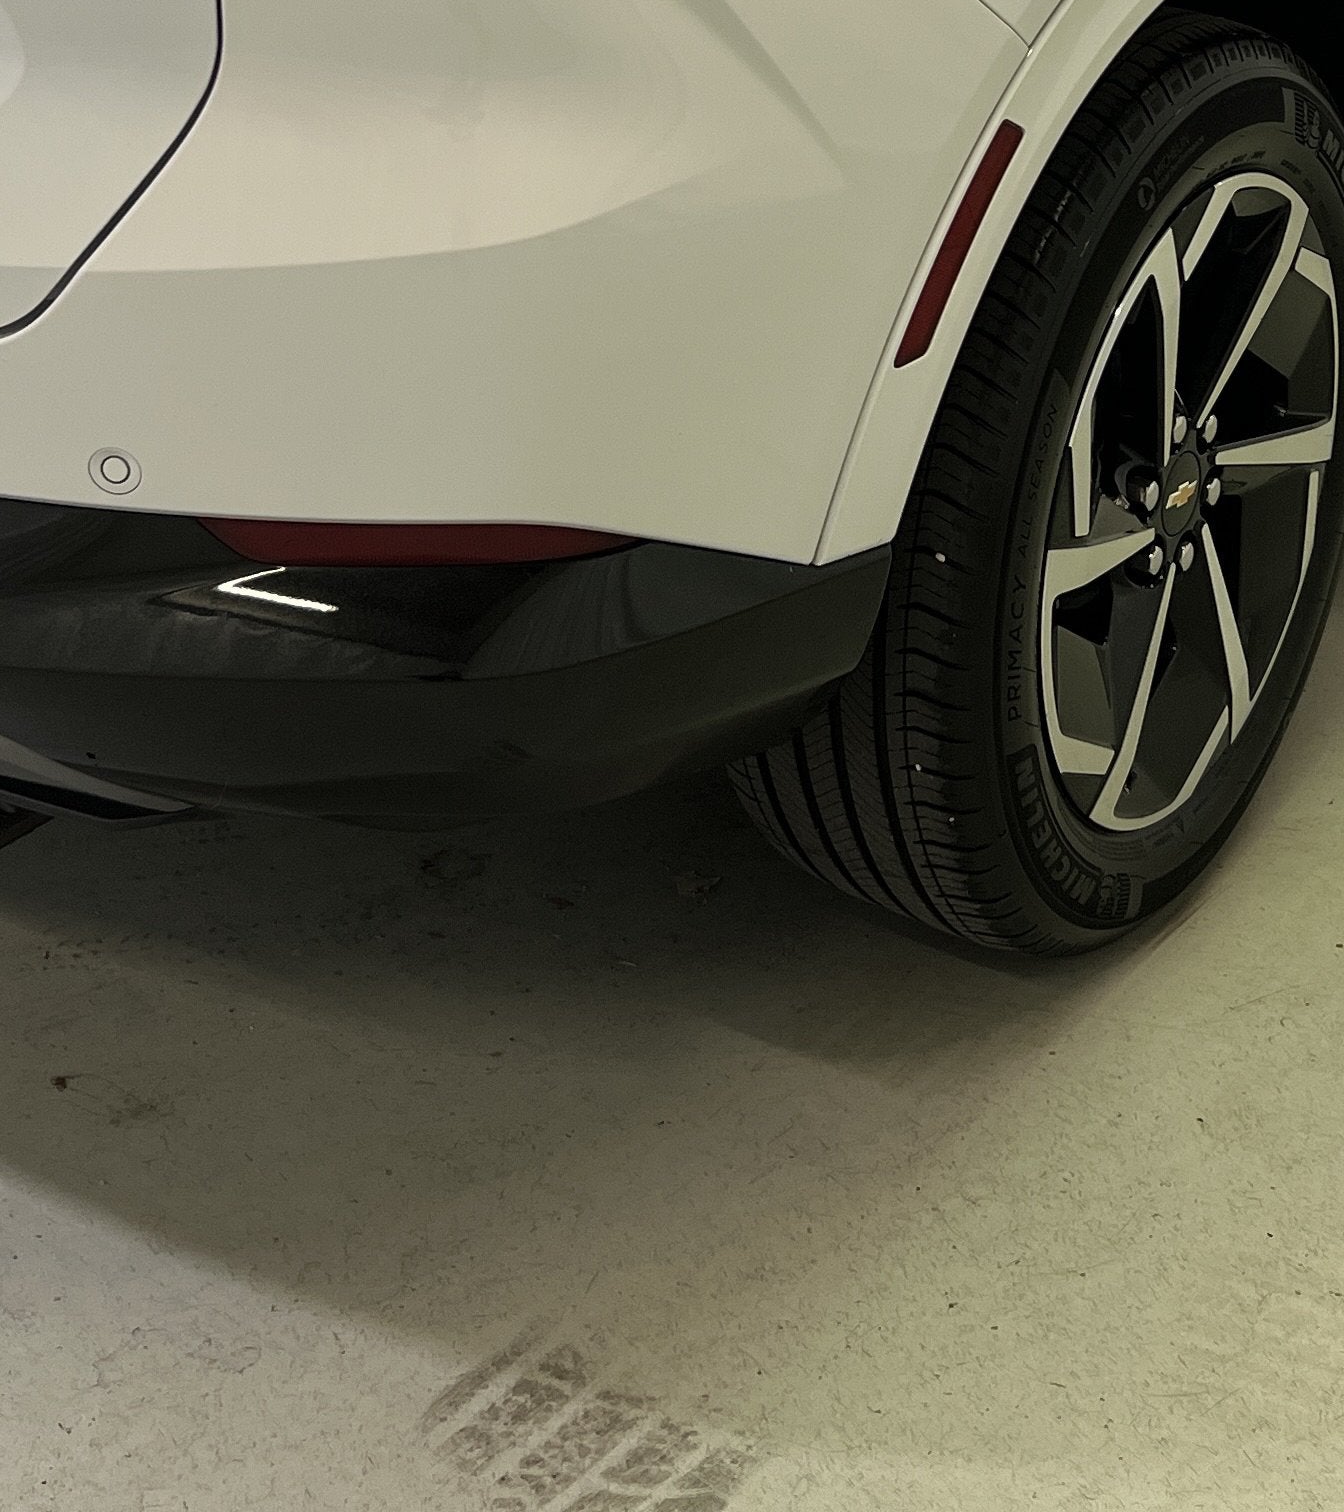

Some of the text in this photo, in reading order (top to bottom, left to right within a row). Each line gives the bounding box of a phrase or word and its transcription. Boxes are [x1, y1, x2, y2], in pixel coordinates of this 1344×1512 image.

[1007, 404, 1058, 722] PRIMACY ALL SEASON
[1014, 755, 1097, 906] MICHELIN
